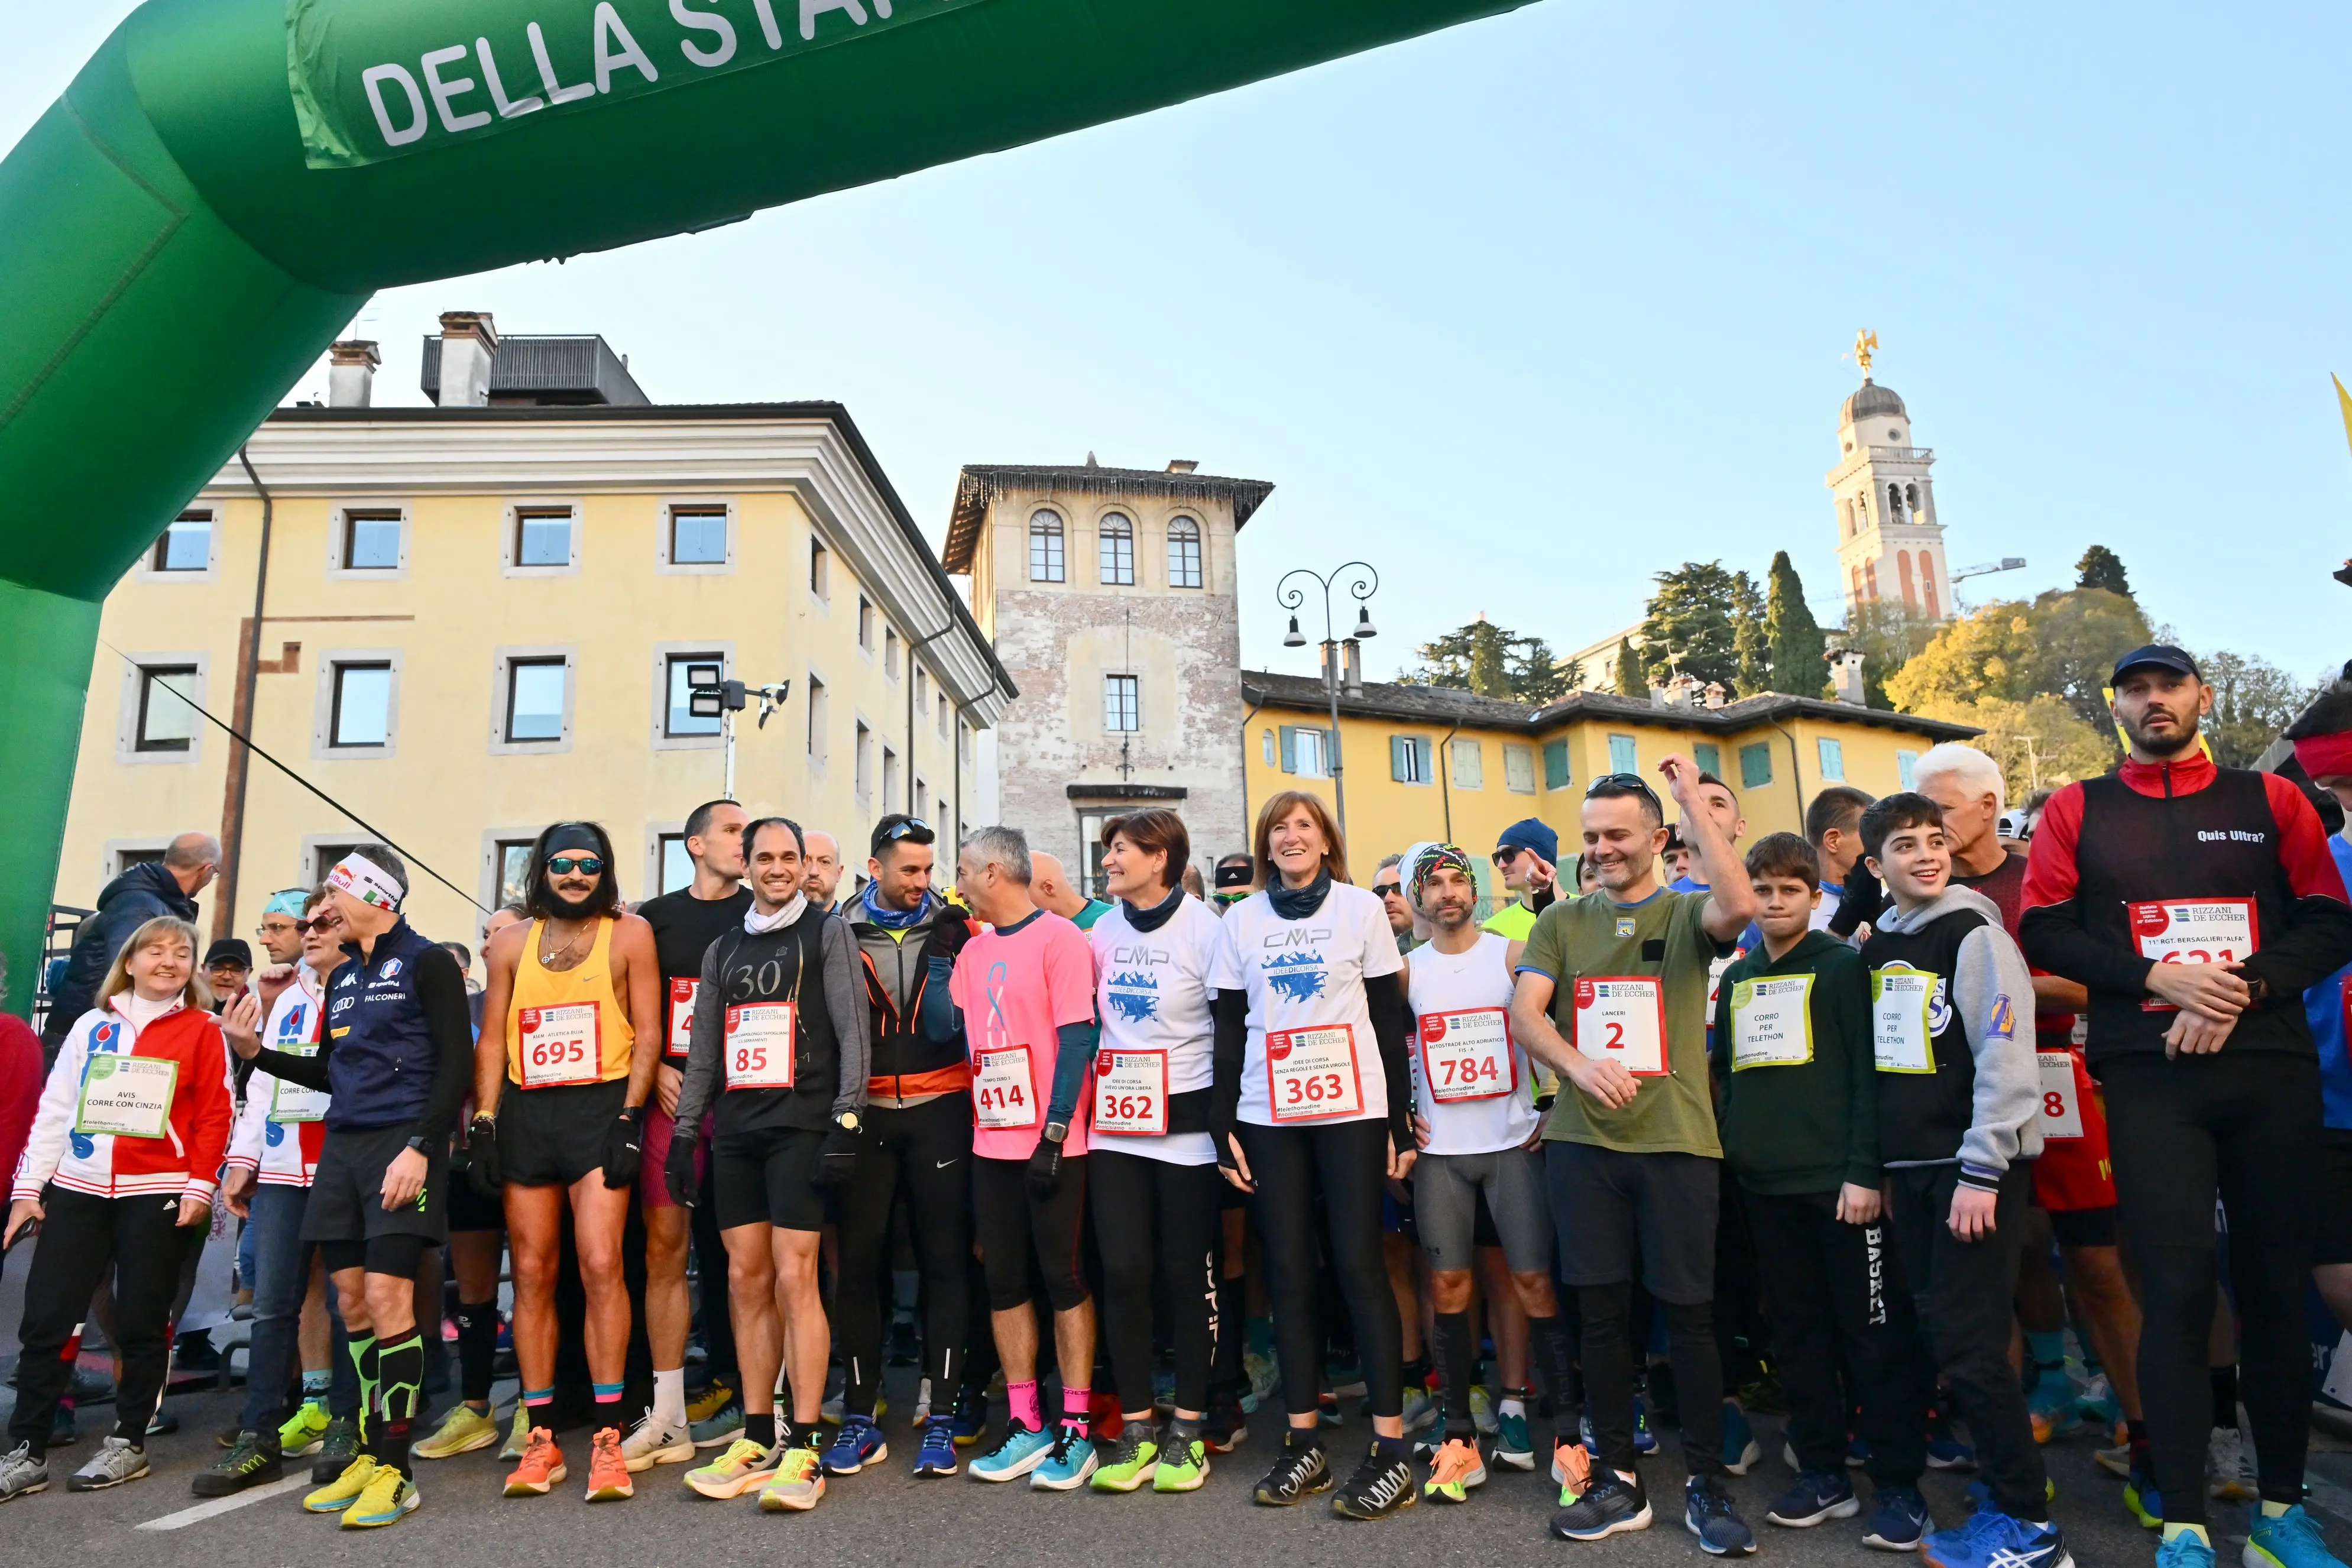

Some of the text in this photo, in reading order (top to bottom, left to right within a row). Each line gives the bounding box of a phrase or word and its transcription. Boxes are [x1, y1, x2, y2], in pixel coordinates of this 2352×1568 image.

[362, 1, 660, 147] DELLA
[2198, 830, 2264, 843] Quis Ultra?
[1264, 928, 1332, 947] CMP
[1114, 945, 1169, 966] CMP
[1274, 964, 1318, 975] IDEEDICORSA
[1769, 981, 1796, 989] RIZZANI
[365, 993, 406, 1002] FALCONERI
[1754, 1013, 1779, 1021] CORRO
[1605, 1022, 1624, 1048] 2
[1748, 1032, 1783, 1043] TELETHON
[533, 1040, 584, 1065] 695
[736, 1048, 766, 1071] 85
[991, 1052, 1016, 1061] RIZZANI
[1440, 1055, 1499, 1085] 784
[980, 1085, 1024, 1110] 414
[1286, 1074, 1343, 1103] 363
[1105, 1095, 1152, 1119] 362
[1277, 1104, 1321, 1112] #telethonudine
[1865, 1226, 1886, 1324] BASKET
